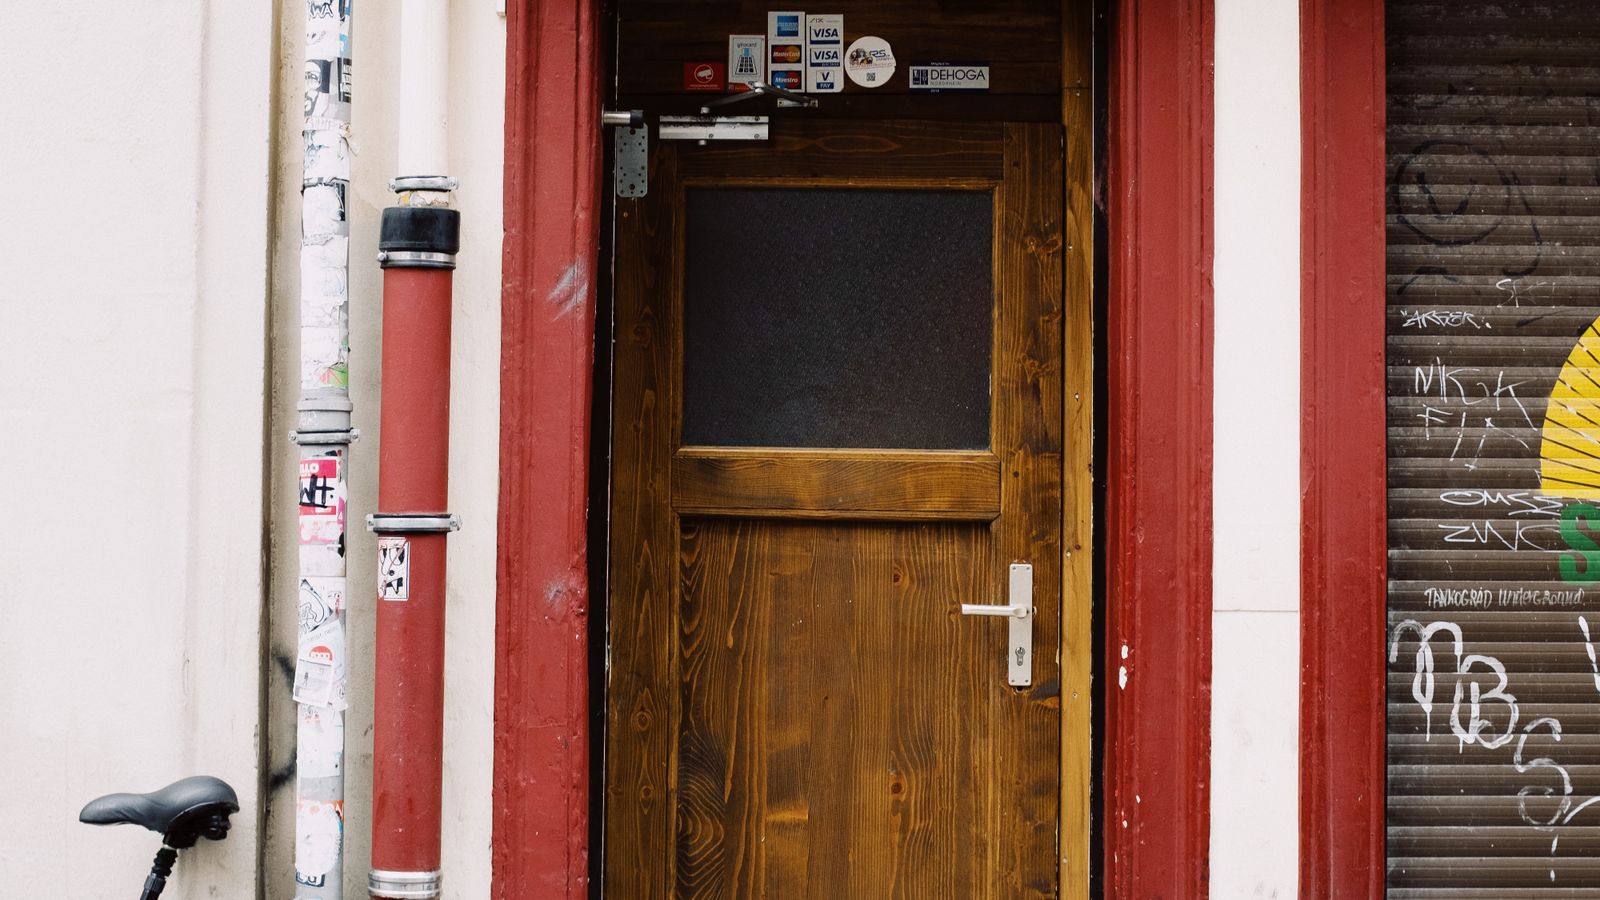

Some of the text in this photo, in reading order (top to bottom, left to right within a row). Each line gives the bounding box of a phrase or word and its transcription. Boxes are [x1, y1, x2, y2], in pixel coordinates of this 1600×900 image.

[813, 28, 839, 38] VISA
[813, 51, 839, 60] VISA
[930, 69, 986, 81] DEHOGA
